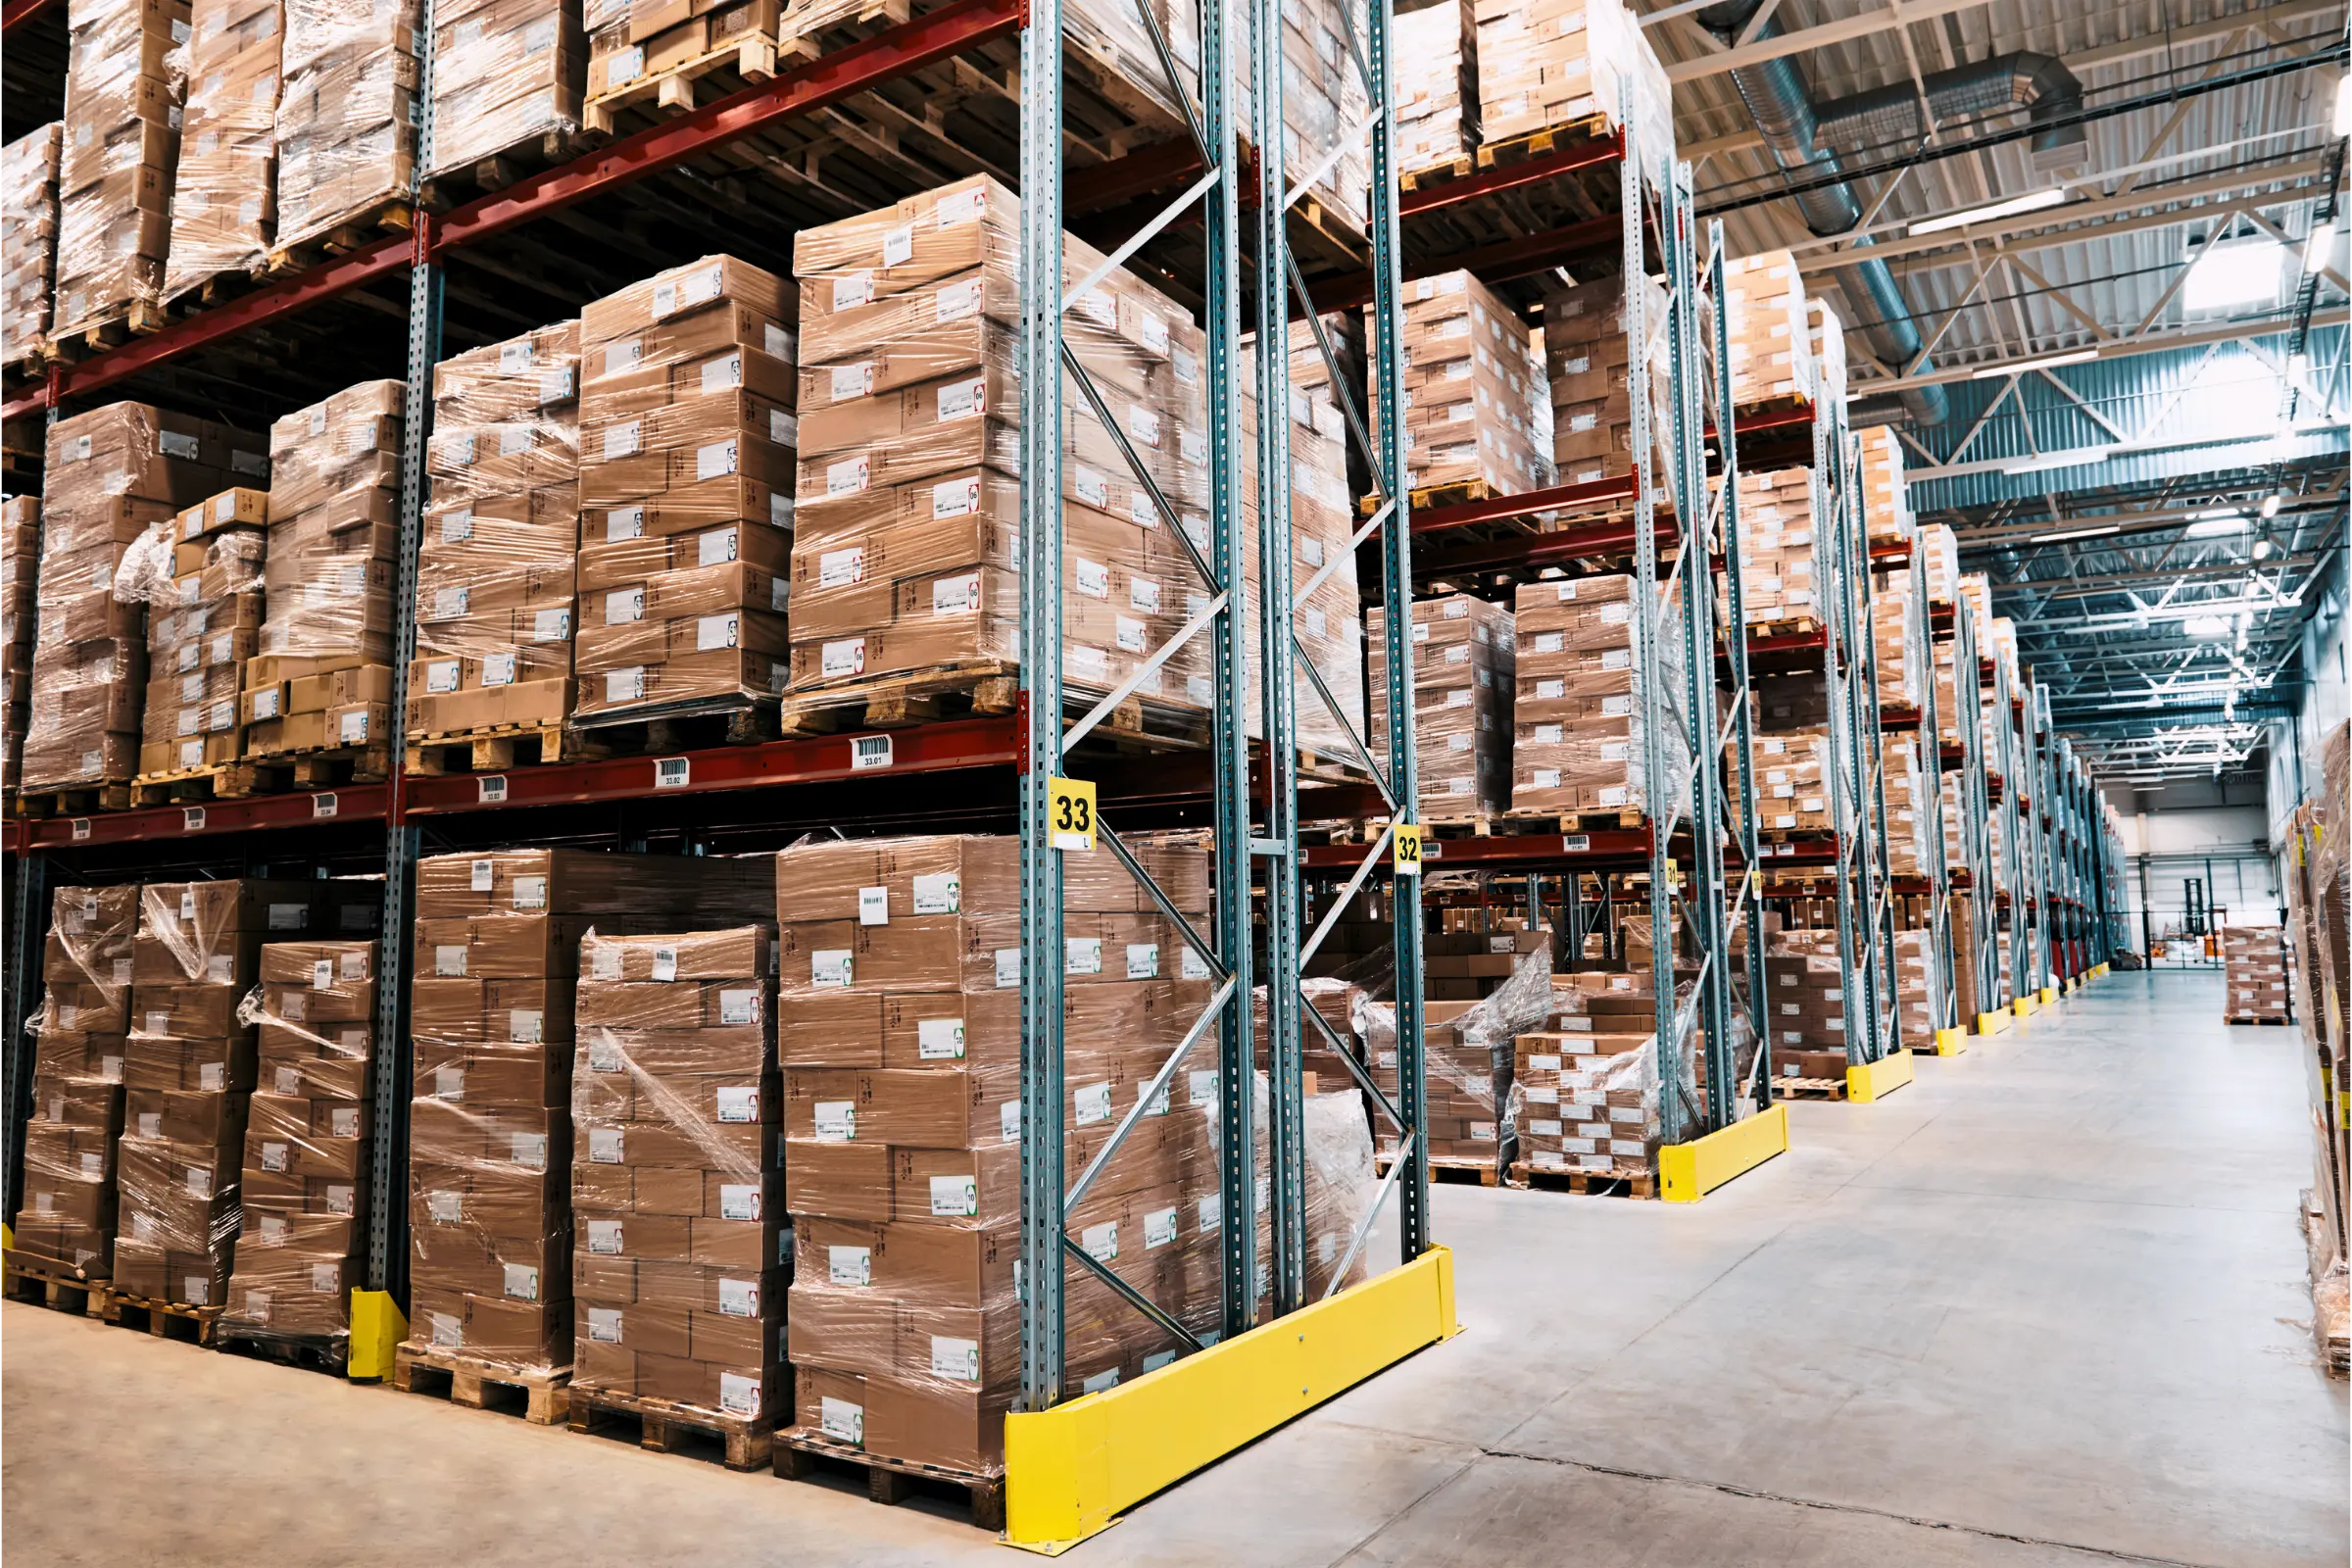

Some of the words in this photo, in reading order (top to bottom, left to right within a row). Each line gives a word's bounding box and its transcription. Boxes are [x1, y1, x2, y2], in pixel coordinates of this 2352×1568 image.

[865, 757, 882, 766] 33.01
[1056, 796, 1090, 831] 33
[1399, 837, 1417, 860] 32
